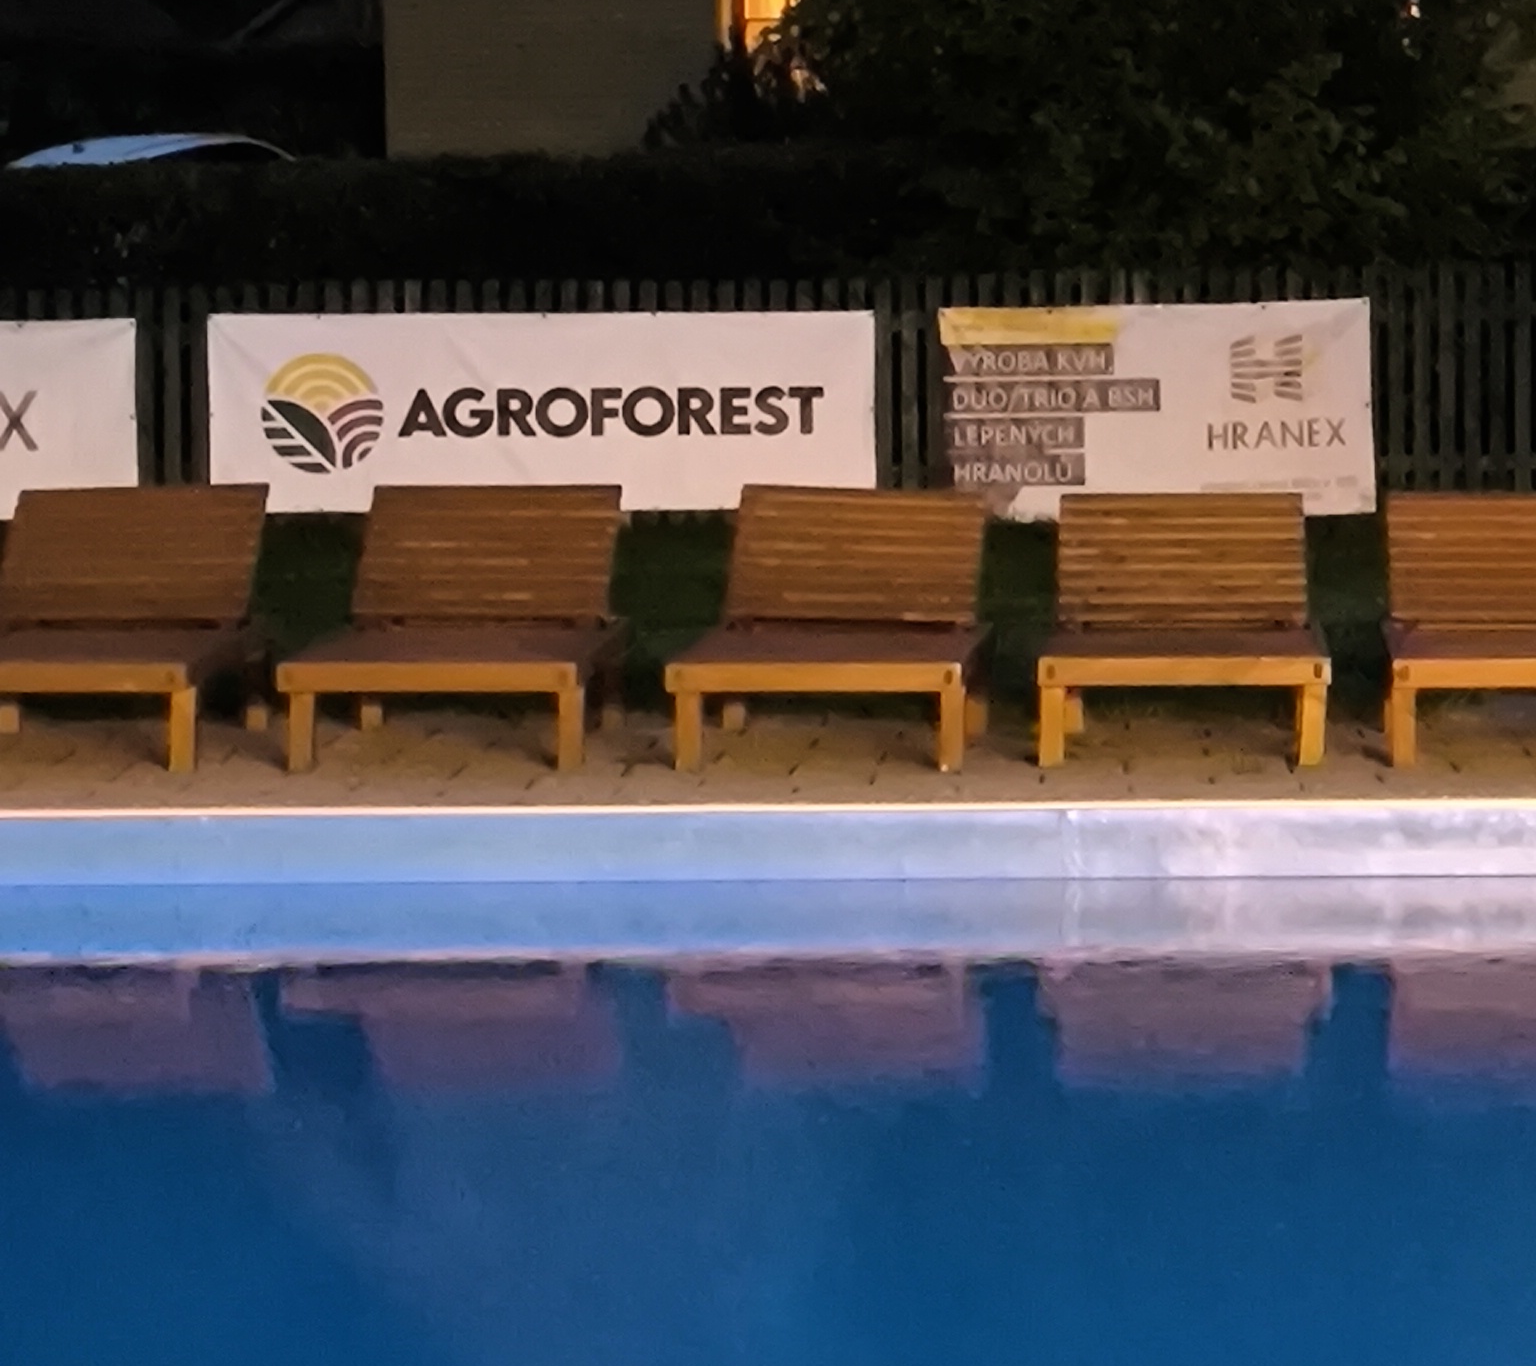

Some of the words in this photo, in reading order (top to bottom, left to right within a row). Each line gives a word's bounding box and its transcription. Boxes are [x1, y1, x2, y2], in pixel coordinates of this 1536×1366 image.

[398, 386, 824, 437] AGROFOREST
[1083, 388, 1099, 408] A
[1206, 418, 1346, 451] HRANEX
